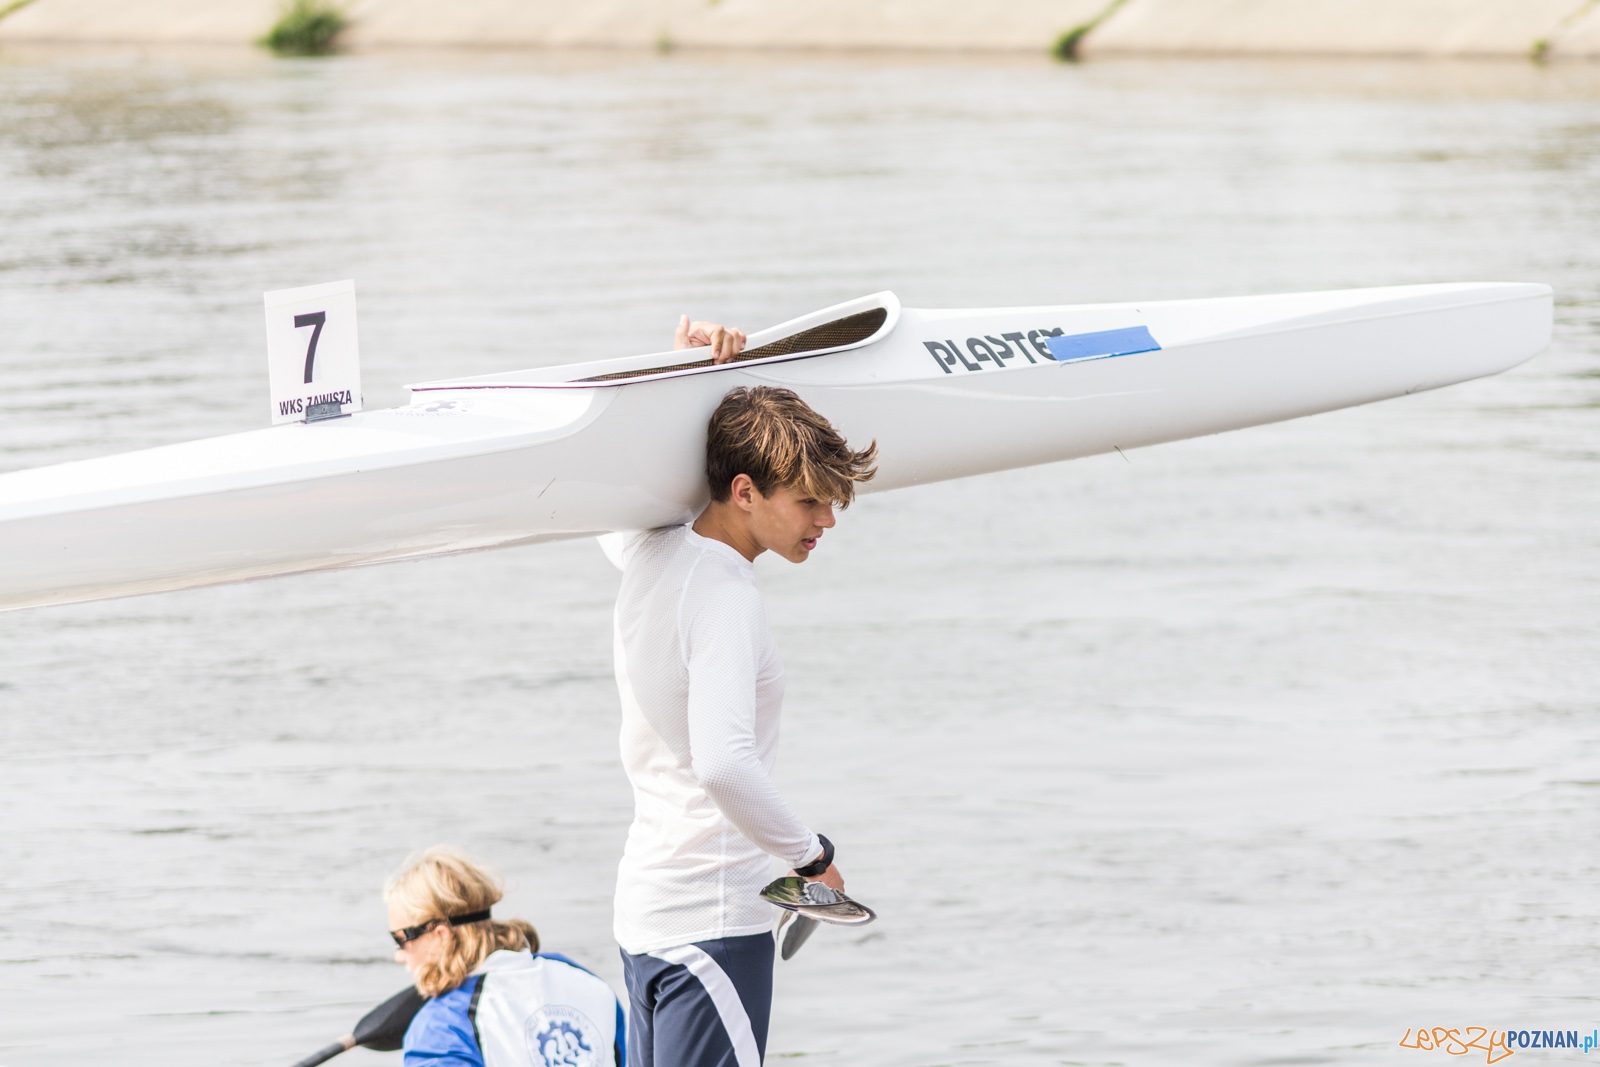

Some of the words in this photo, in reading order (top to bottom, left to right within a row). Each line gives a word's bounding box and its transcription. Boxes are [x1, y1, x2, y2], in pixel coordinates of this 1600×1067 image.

[294, 311, 326, 384] 7
[922, 327, 1065, 374] PLASTE
[279, 398, 304, 416] WKS
